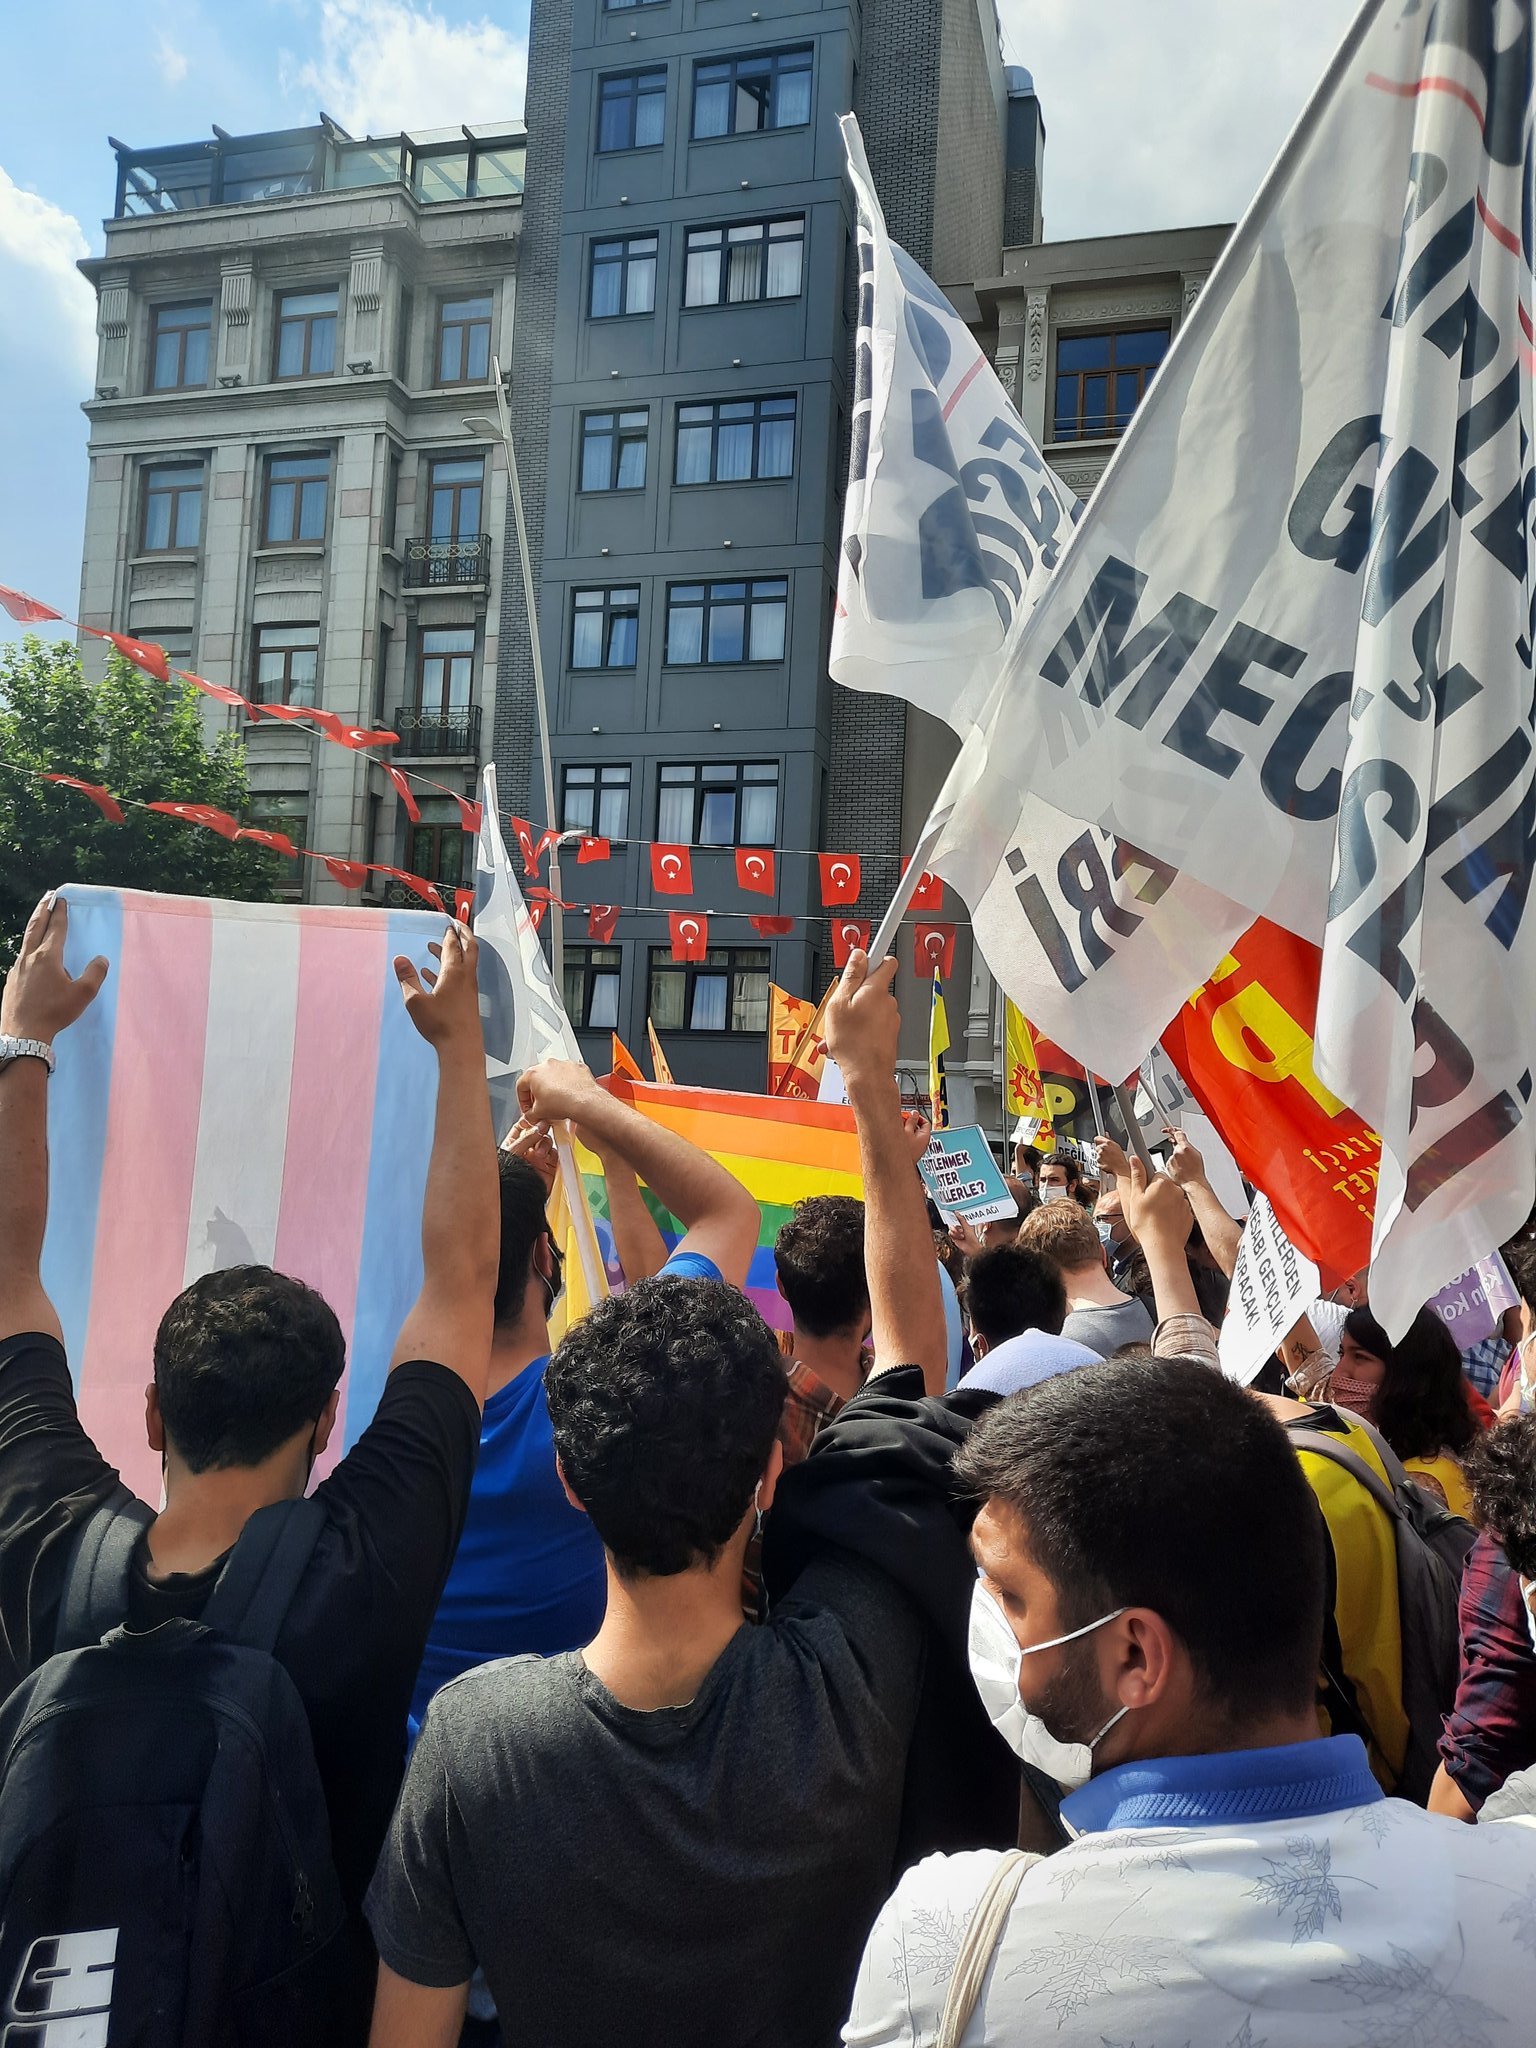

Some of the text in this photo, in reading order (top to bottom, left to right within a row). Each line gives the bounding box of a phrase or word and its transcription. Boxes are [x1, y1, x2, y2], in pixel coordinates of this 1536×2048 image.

[936, 1171, 959, 1187] STER
[963, 1209, 985, 1221] INMA
[1249, 1201, 1287, 1335] HESABI GENÇLİK
